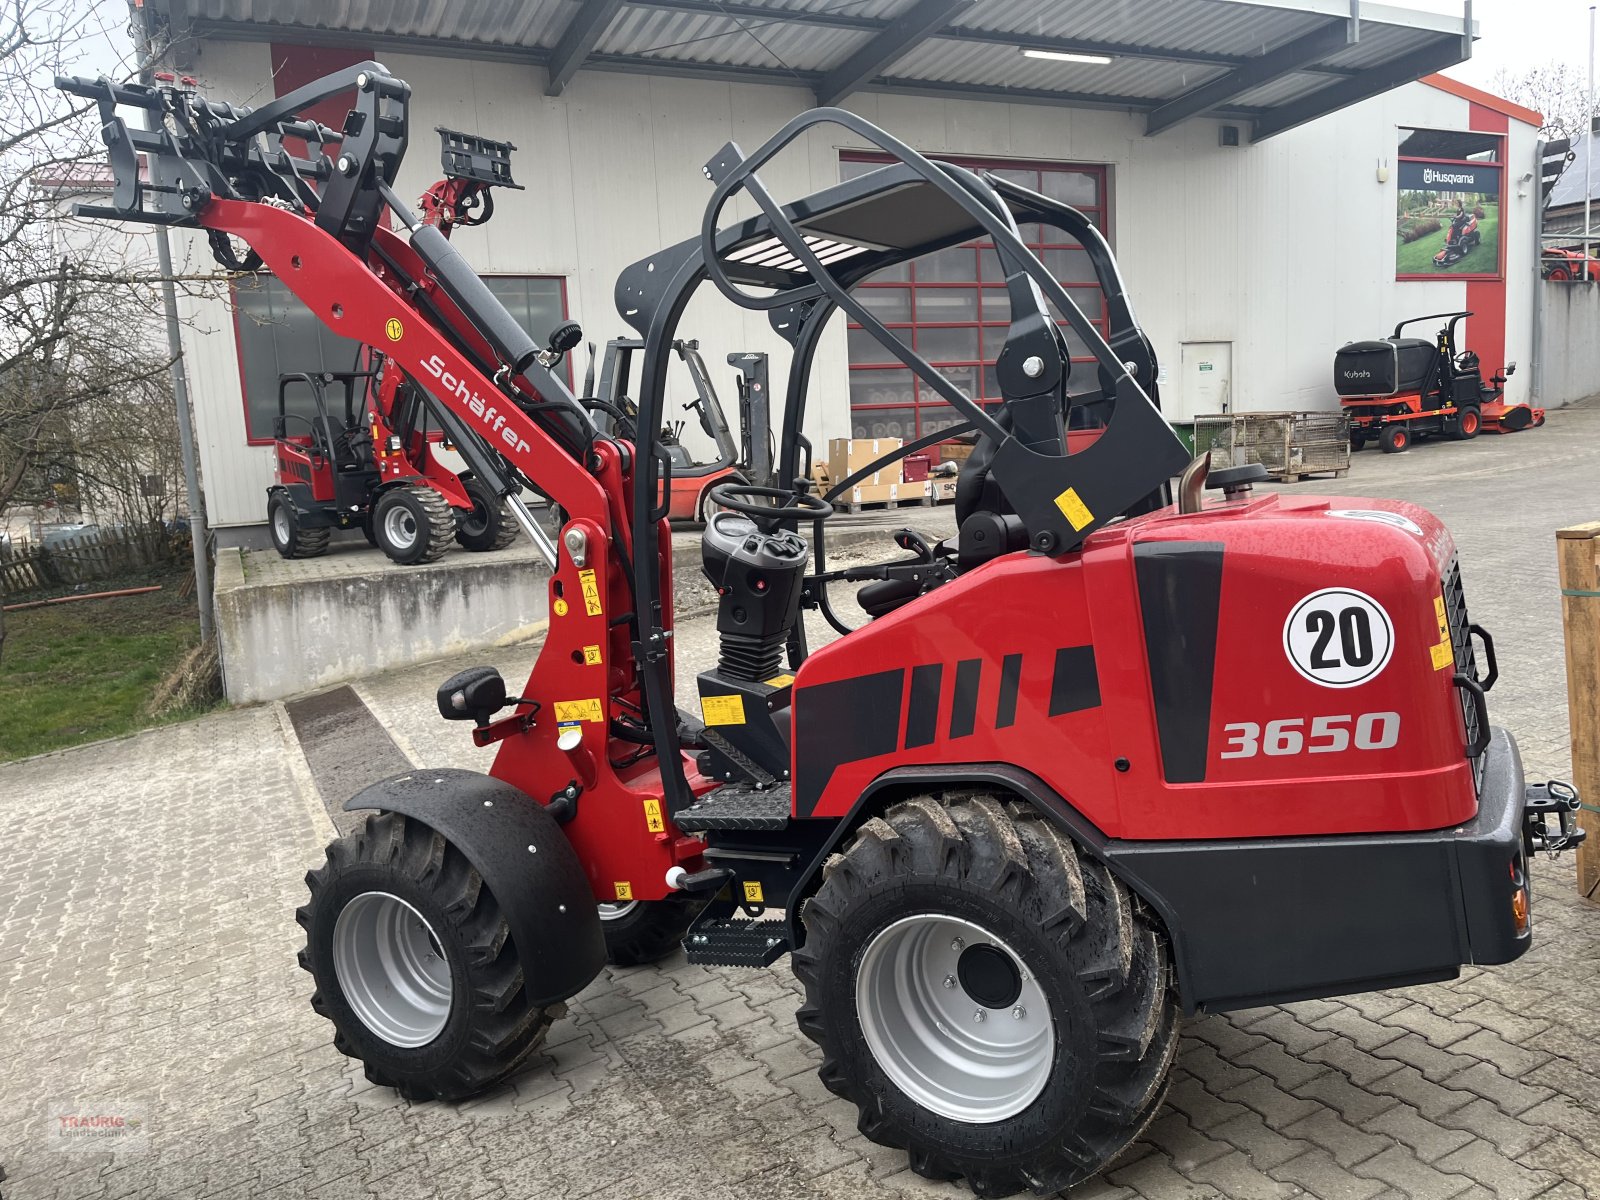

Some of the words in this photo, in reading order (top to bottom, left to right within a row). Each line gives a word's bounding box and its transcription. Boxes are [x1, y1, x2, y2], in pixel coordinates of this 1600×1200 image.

[1432, 170, 1475, 185] Husqvarna
[419, 354, 531, 454] Schäffer
[1305, 606, 1374, 670] 20
[1220, 711, 1401, 760] 3650
